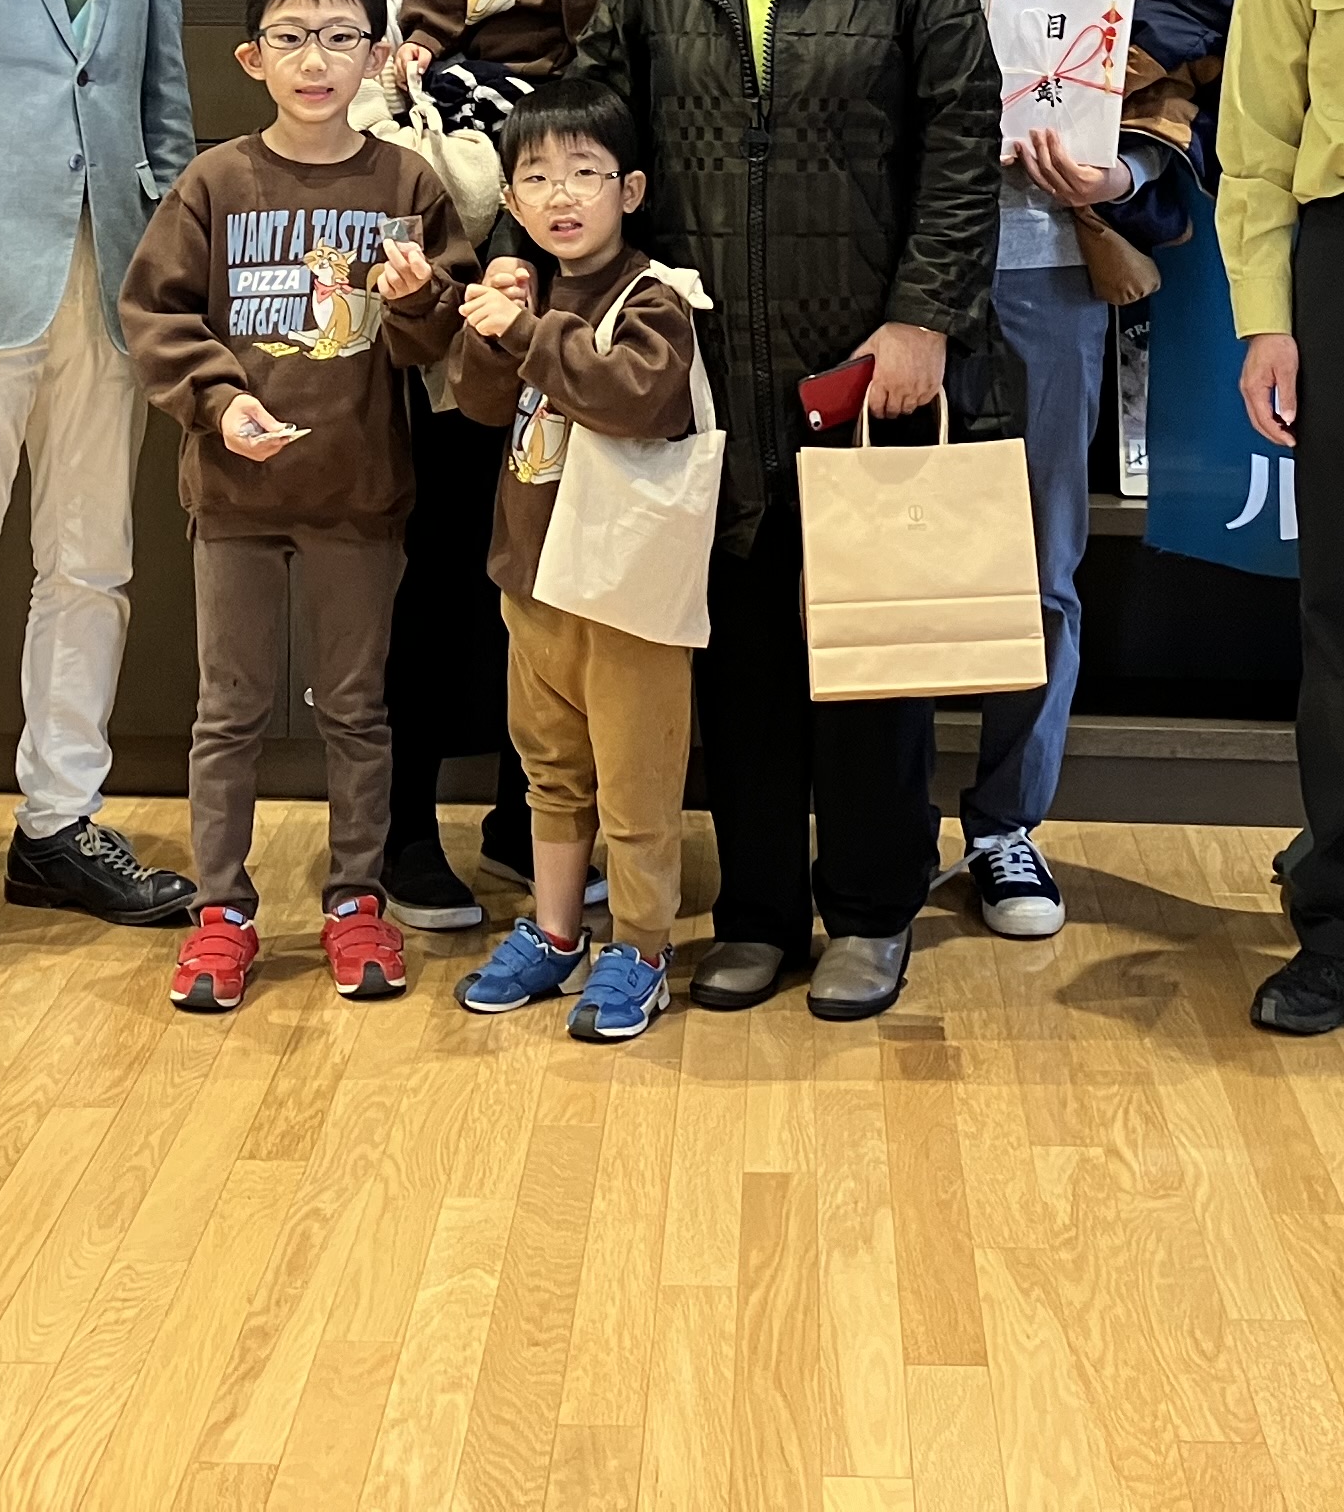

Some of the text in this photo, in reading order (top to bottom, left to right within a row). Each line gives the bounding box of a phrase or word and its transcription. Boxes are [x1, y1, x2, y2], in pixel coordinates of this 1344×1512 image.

[227, 208, 388, 266] WANT A TASTE?
[236, 268, 301, 292] PIZZA
[229, 296, 308, 336] EAT&FUN
